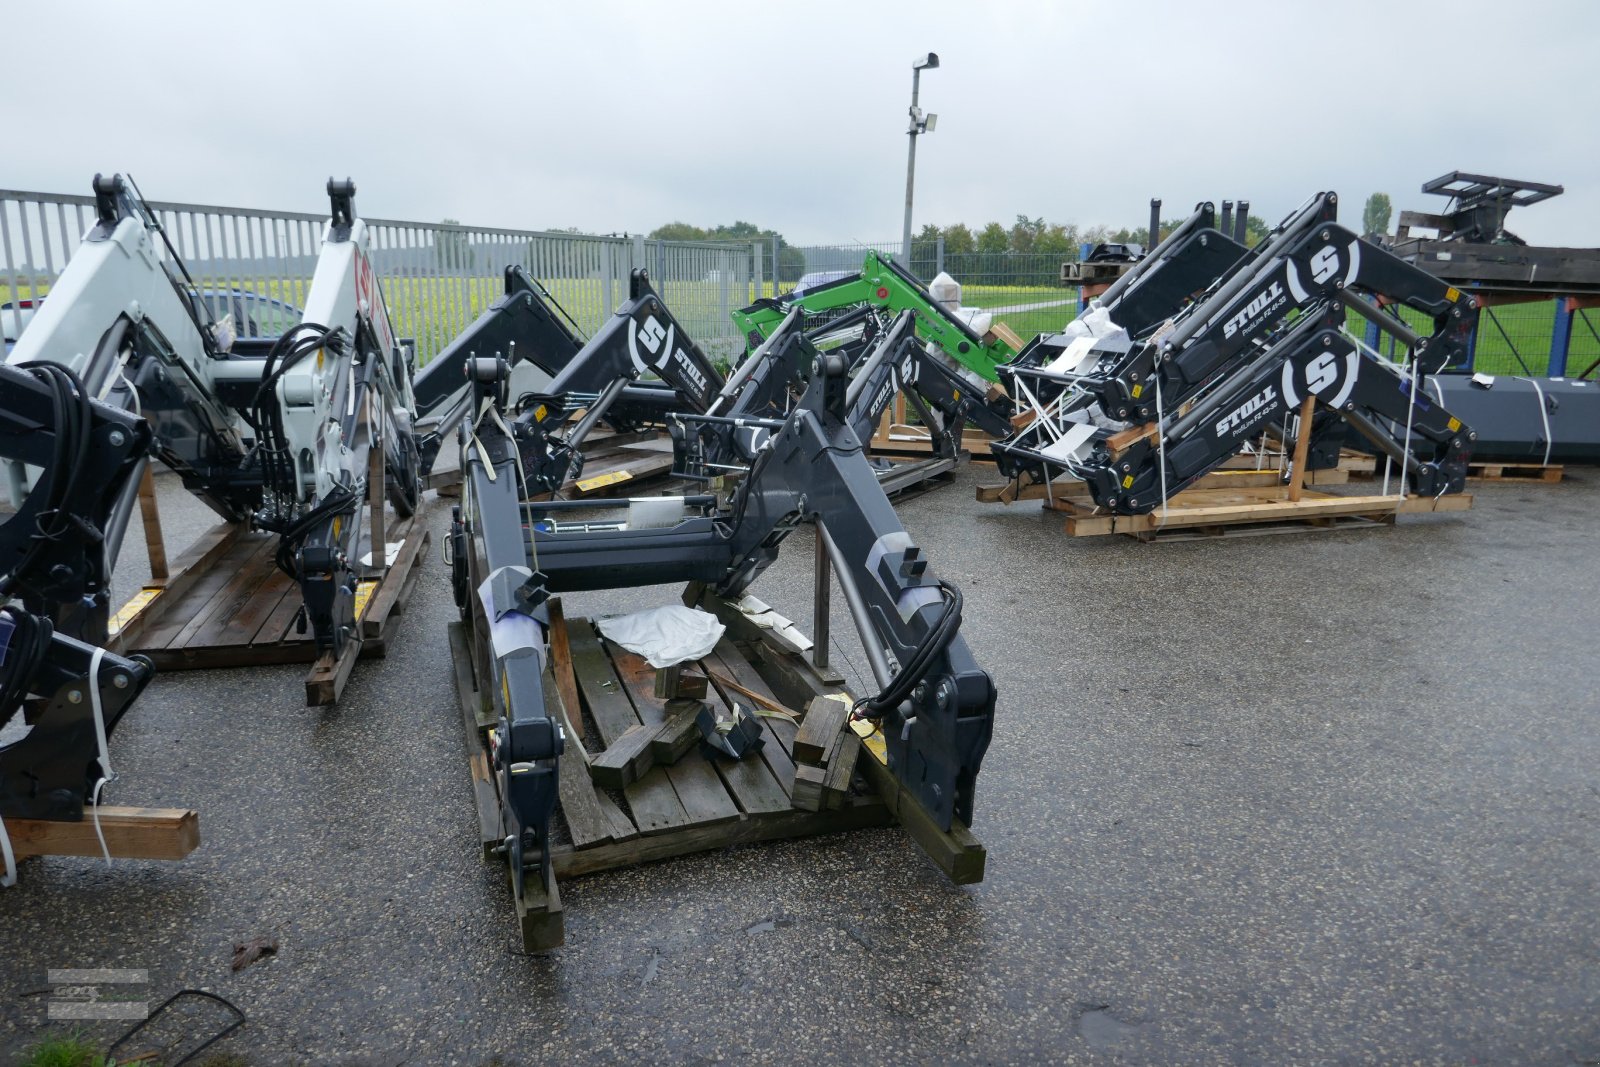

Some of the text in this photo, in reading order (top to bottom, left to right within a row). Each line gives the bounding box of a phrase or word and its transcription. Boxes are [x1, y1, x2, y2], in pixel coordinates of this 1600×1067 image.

[1310, 244, 1340, 285] S
[1223, 281, 1283, 340] STOLL
[637, 314, 667, 354] S
[674, 347, 708, 392] STOLL
[1305, 351, 1338, 395] S
[870, 379, 891, 418] STOLL
[1215, 384, 1277, 438] STOLL
